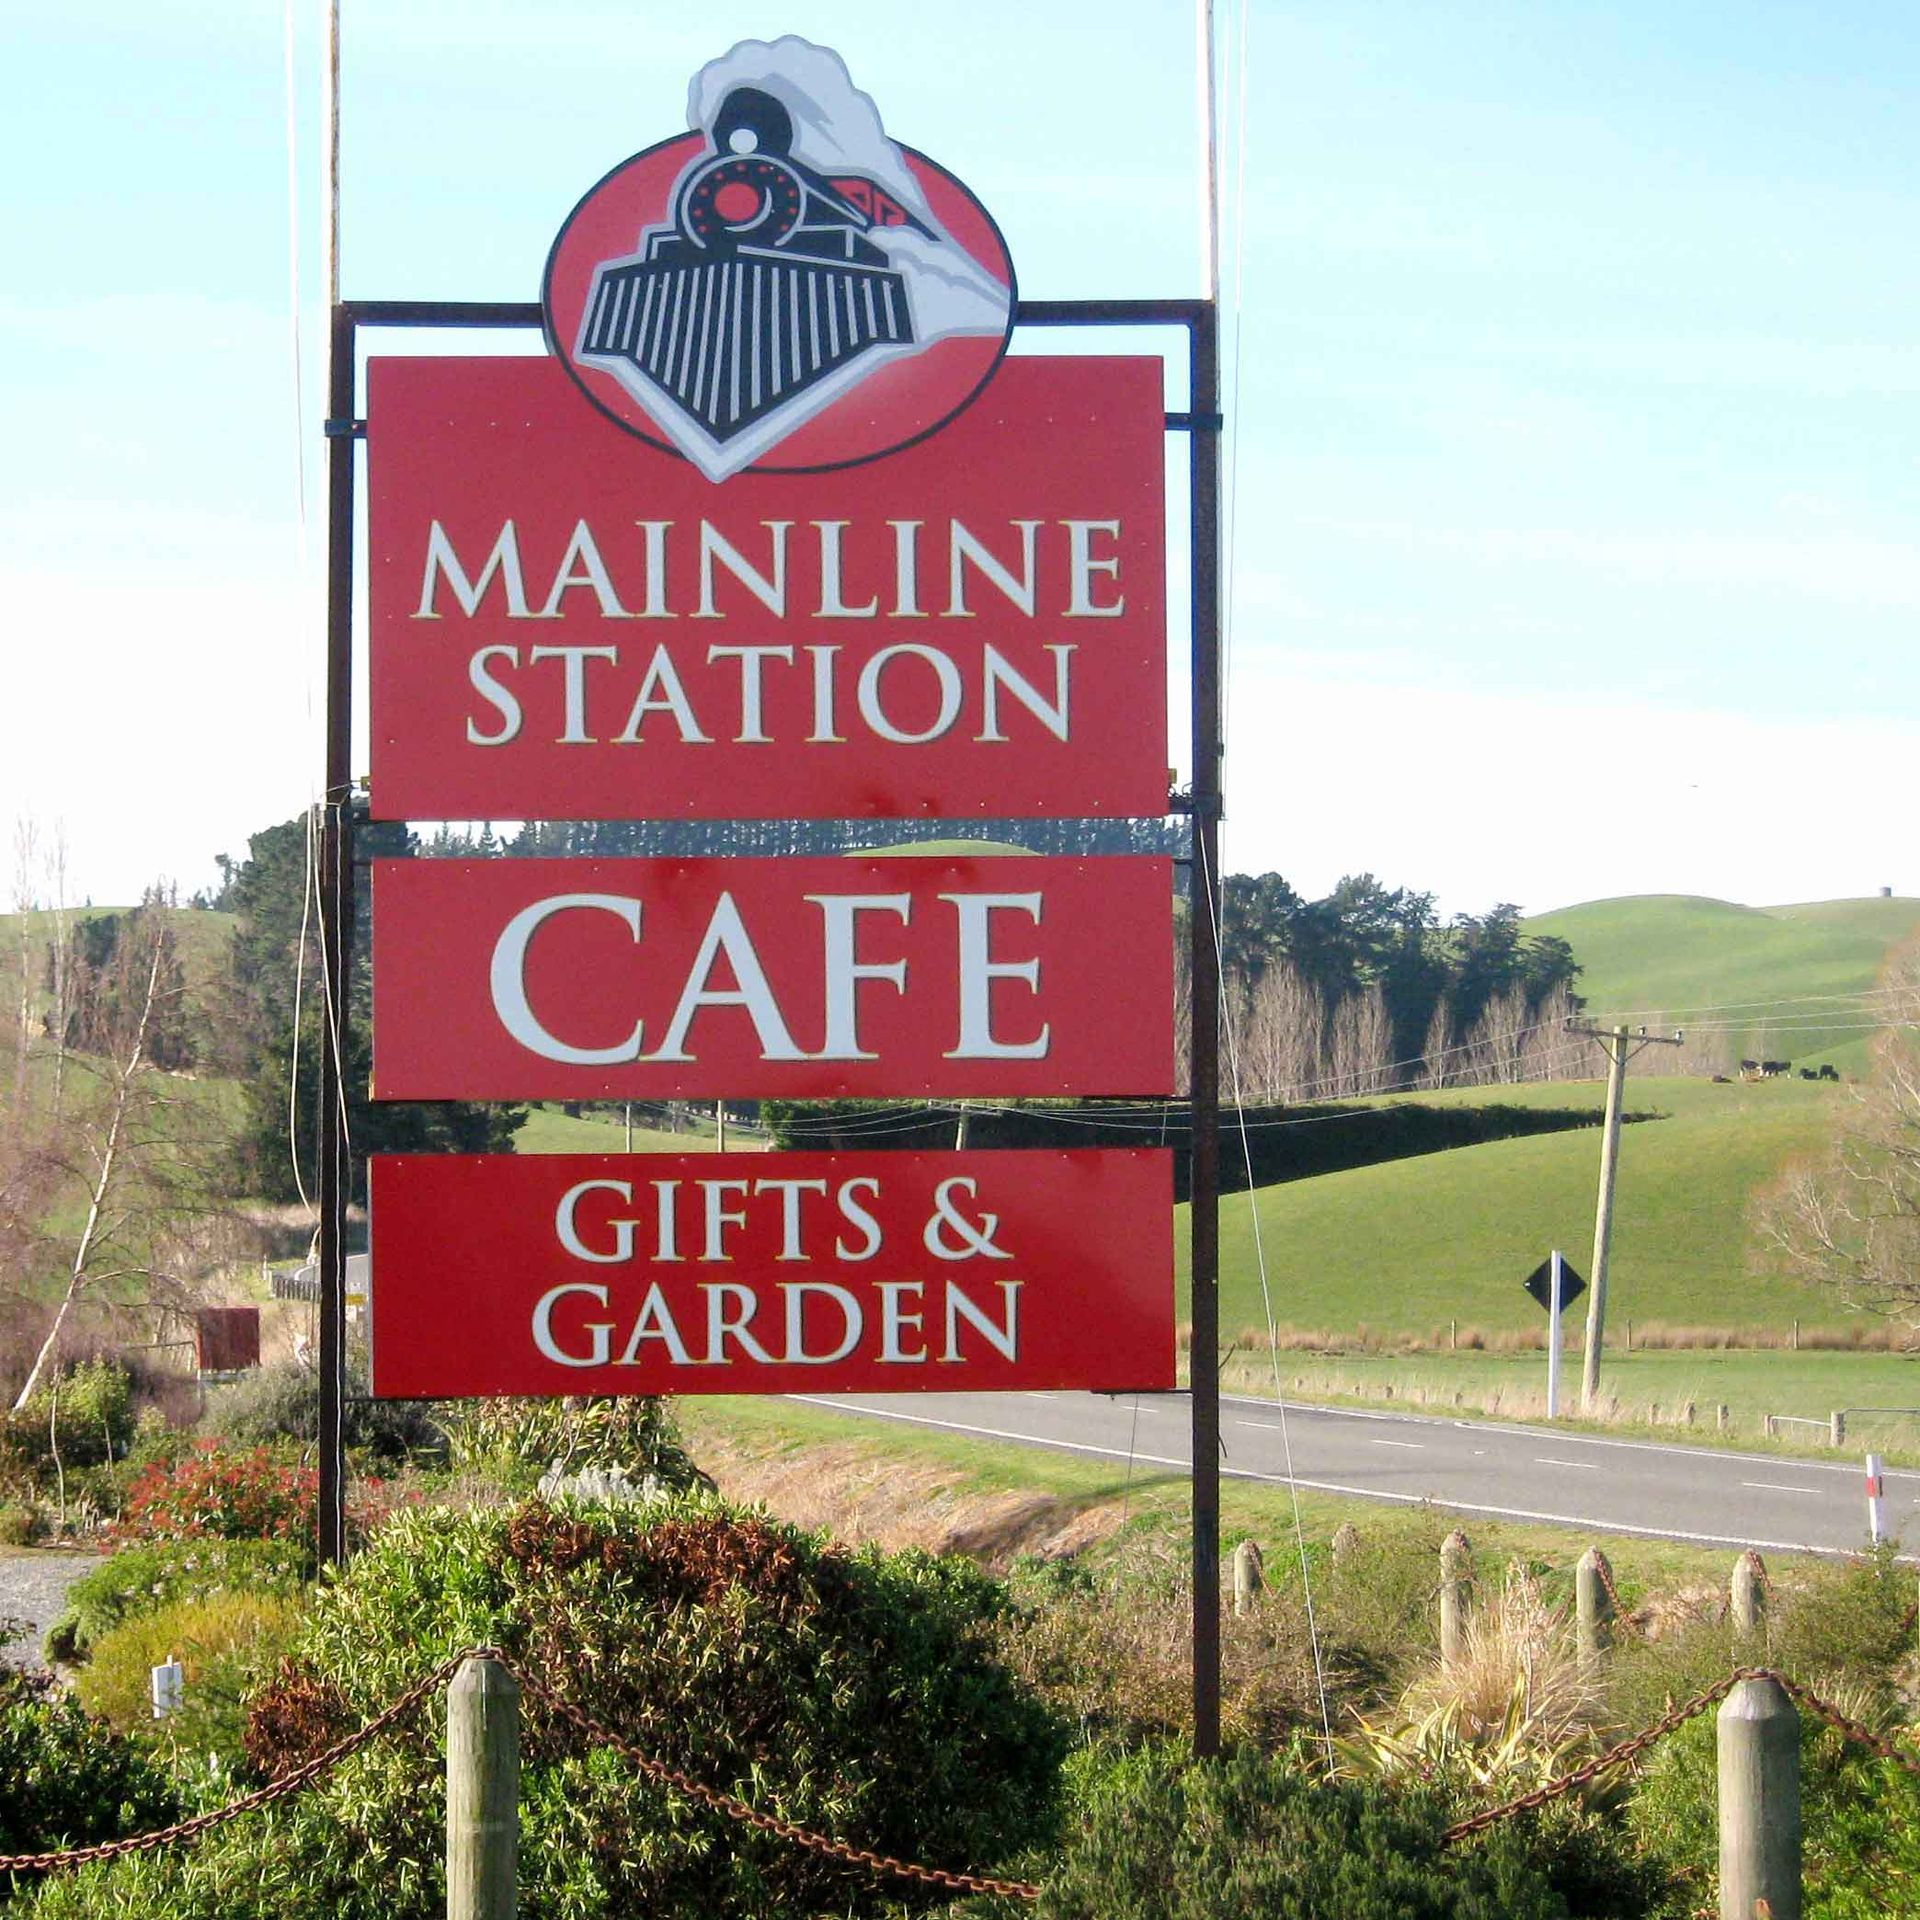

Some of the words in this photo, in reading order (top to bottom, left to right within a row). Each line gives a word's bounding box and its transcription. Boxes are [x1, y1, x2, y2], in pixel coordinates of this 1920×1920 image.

[411, 518, 1125, 619] MAINLINE
[466, 642, 1078, 744] STATION
[488, 890, 1050, 1066] CAFE
[555, 1176, 883, 1265] GIFTS
[922, 1176, 1014, 1262] &
[531, 1280, 1023, 1369] GARDEN
